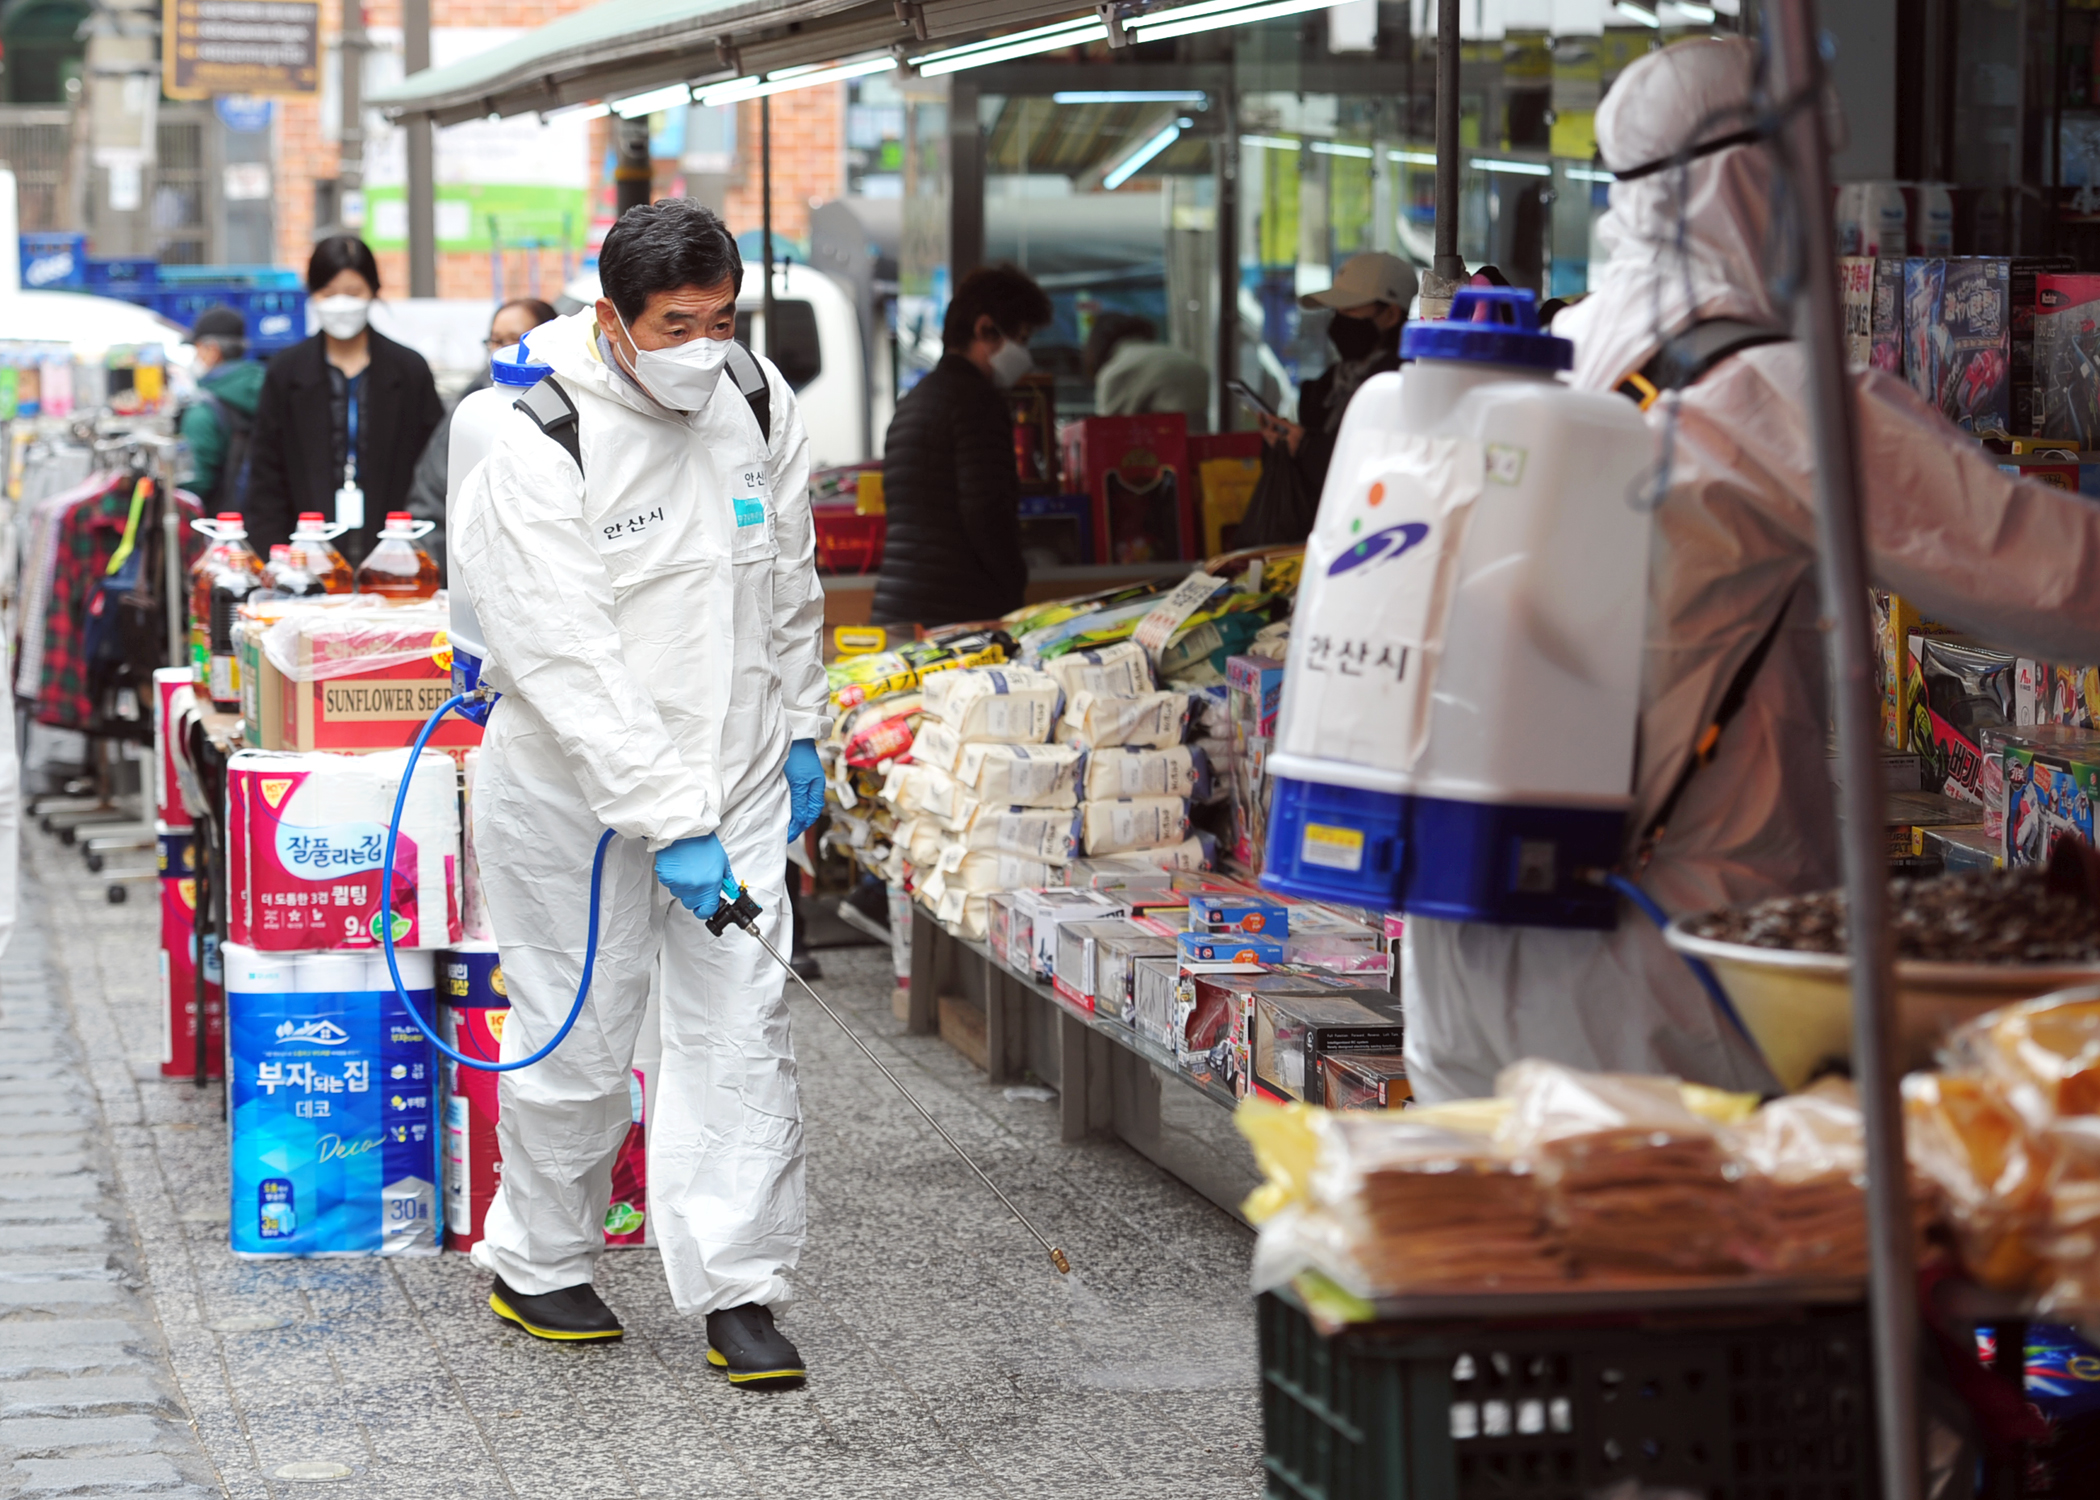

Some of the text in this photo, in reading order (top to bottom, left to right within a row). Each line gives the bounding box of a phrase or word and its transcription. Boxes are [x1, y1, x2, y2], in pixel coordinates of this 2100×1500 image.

[603, 506, 664, 540] 안산시
[1307, 634, 1410, 683] 안산시
[326, 688, 414, 713] SUNFLOWER
[286, 833, 382, 868] 잘풀리는집
[261, 884, 367, 906] 더 도톰한 3겹 퀼팅
[256, 1060, 370, 1095] 부자되는집
[295, 1099, 331, 1119] 데코
[315, 1132, 388, 1164] Deco
